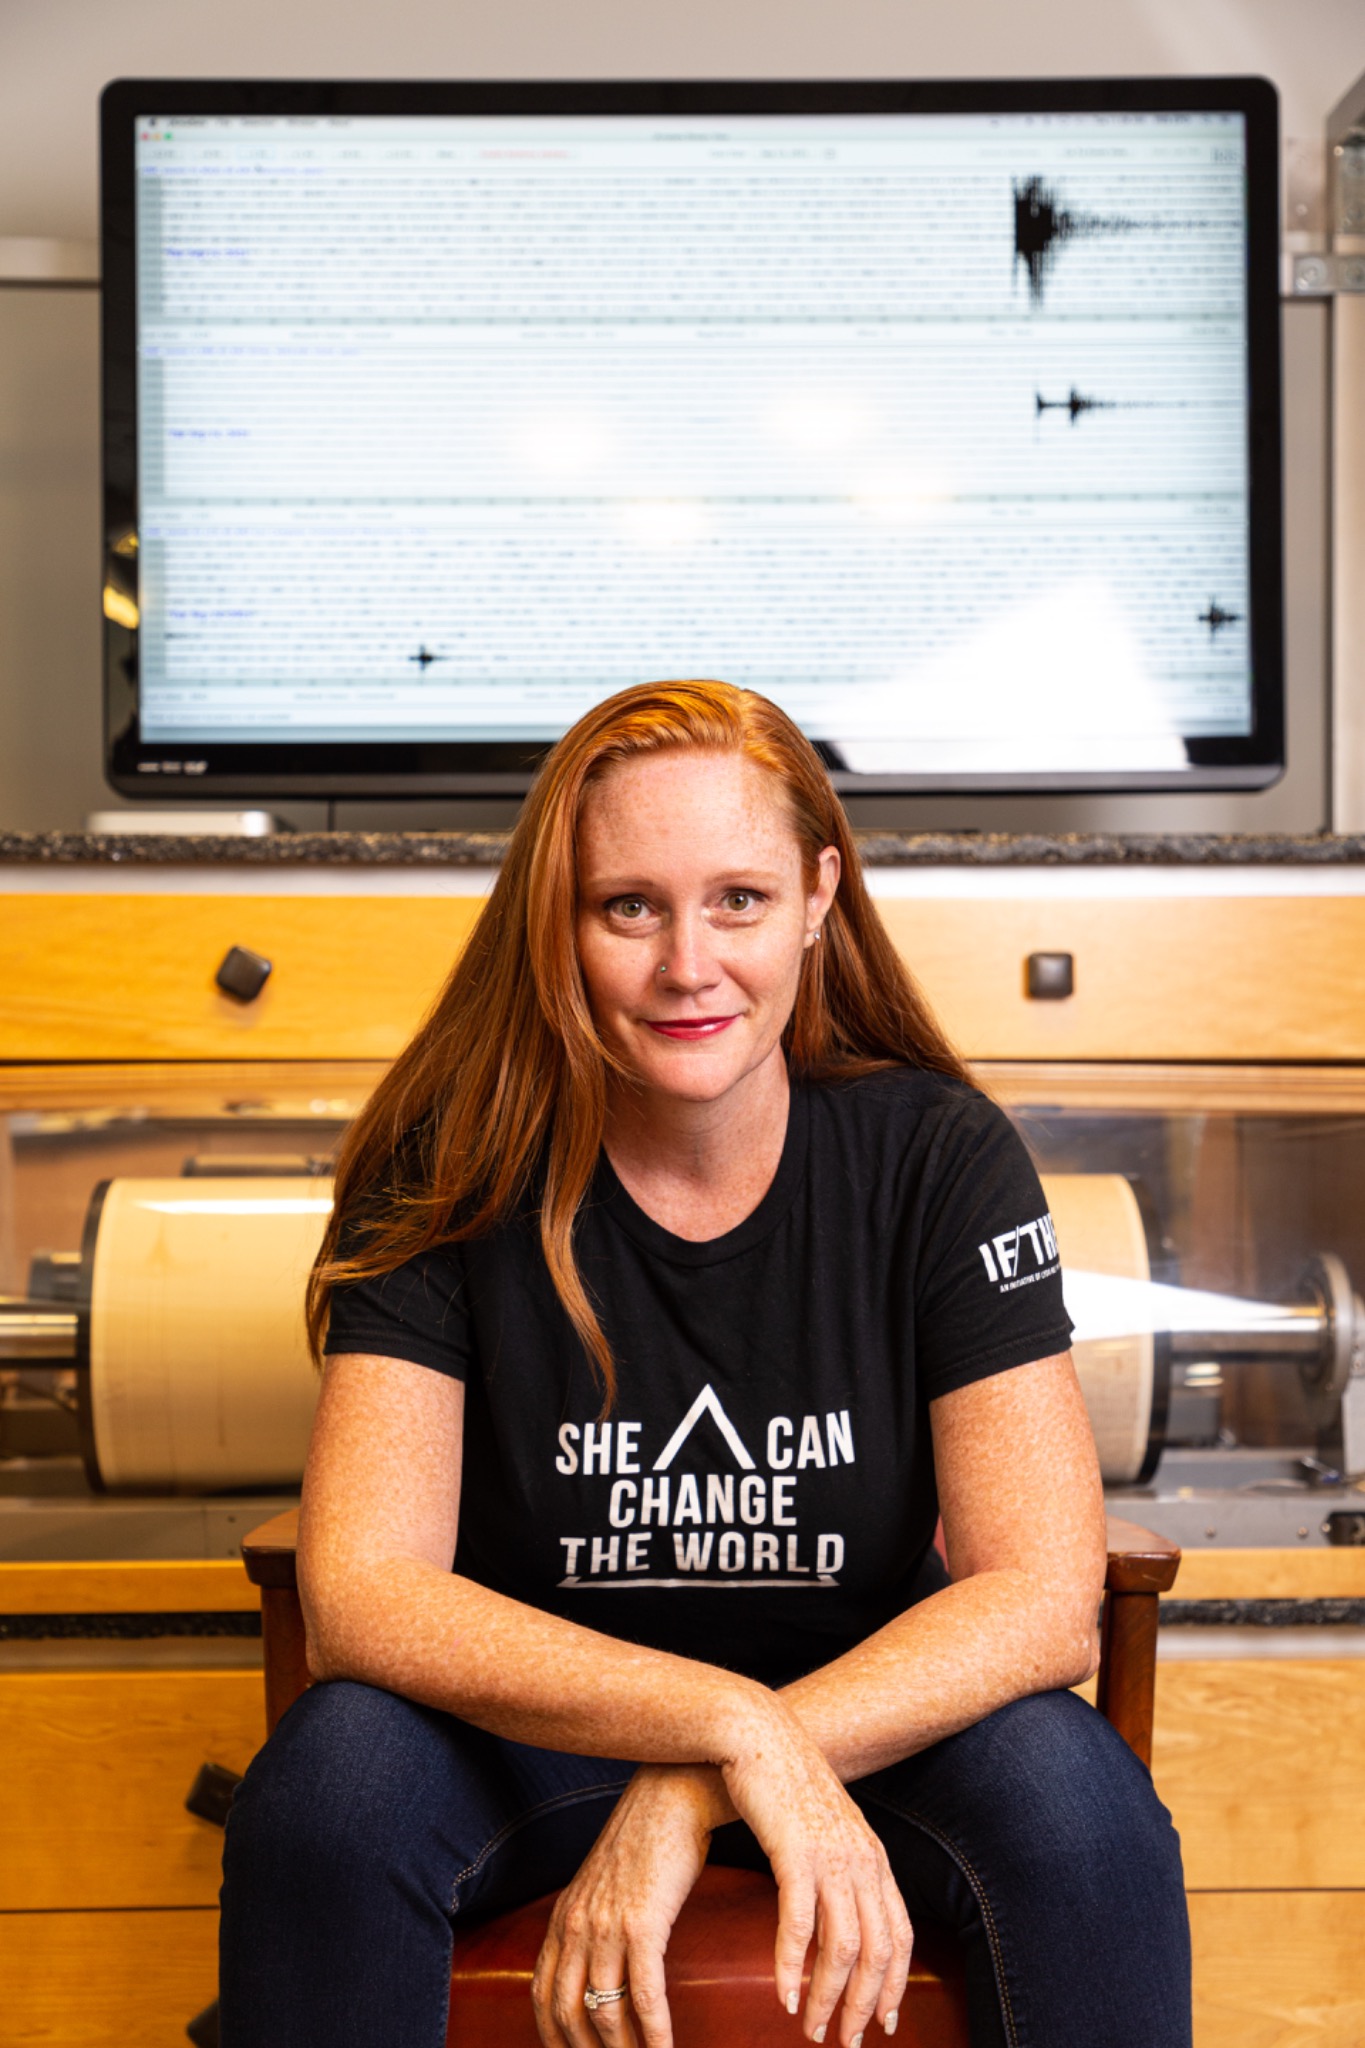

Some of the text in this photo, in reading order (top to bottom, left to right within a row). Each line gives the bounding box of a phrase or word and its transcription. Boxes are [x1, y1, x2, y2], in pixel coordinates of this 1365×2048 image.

[978, 1212, 1058, 1283] IF/TH
[555, 1409, 856, 1476] SHE CAN
[608, 1473, 798, 1529] CHANGE
[559, 1531, 845, 1575] THE WORLD
